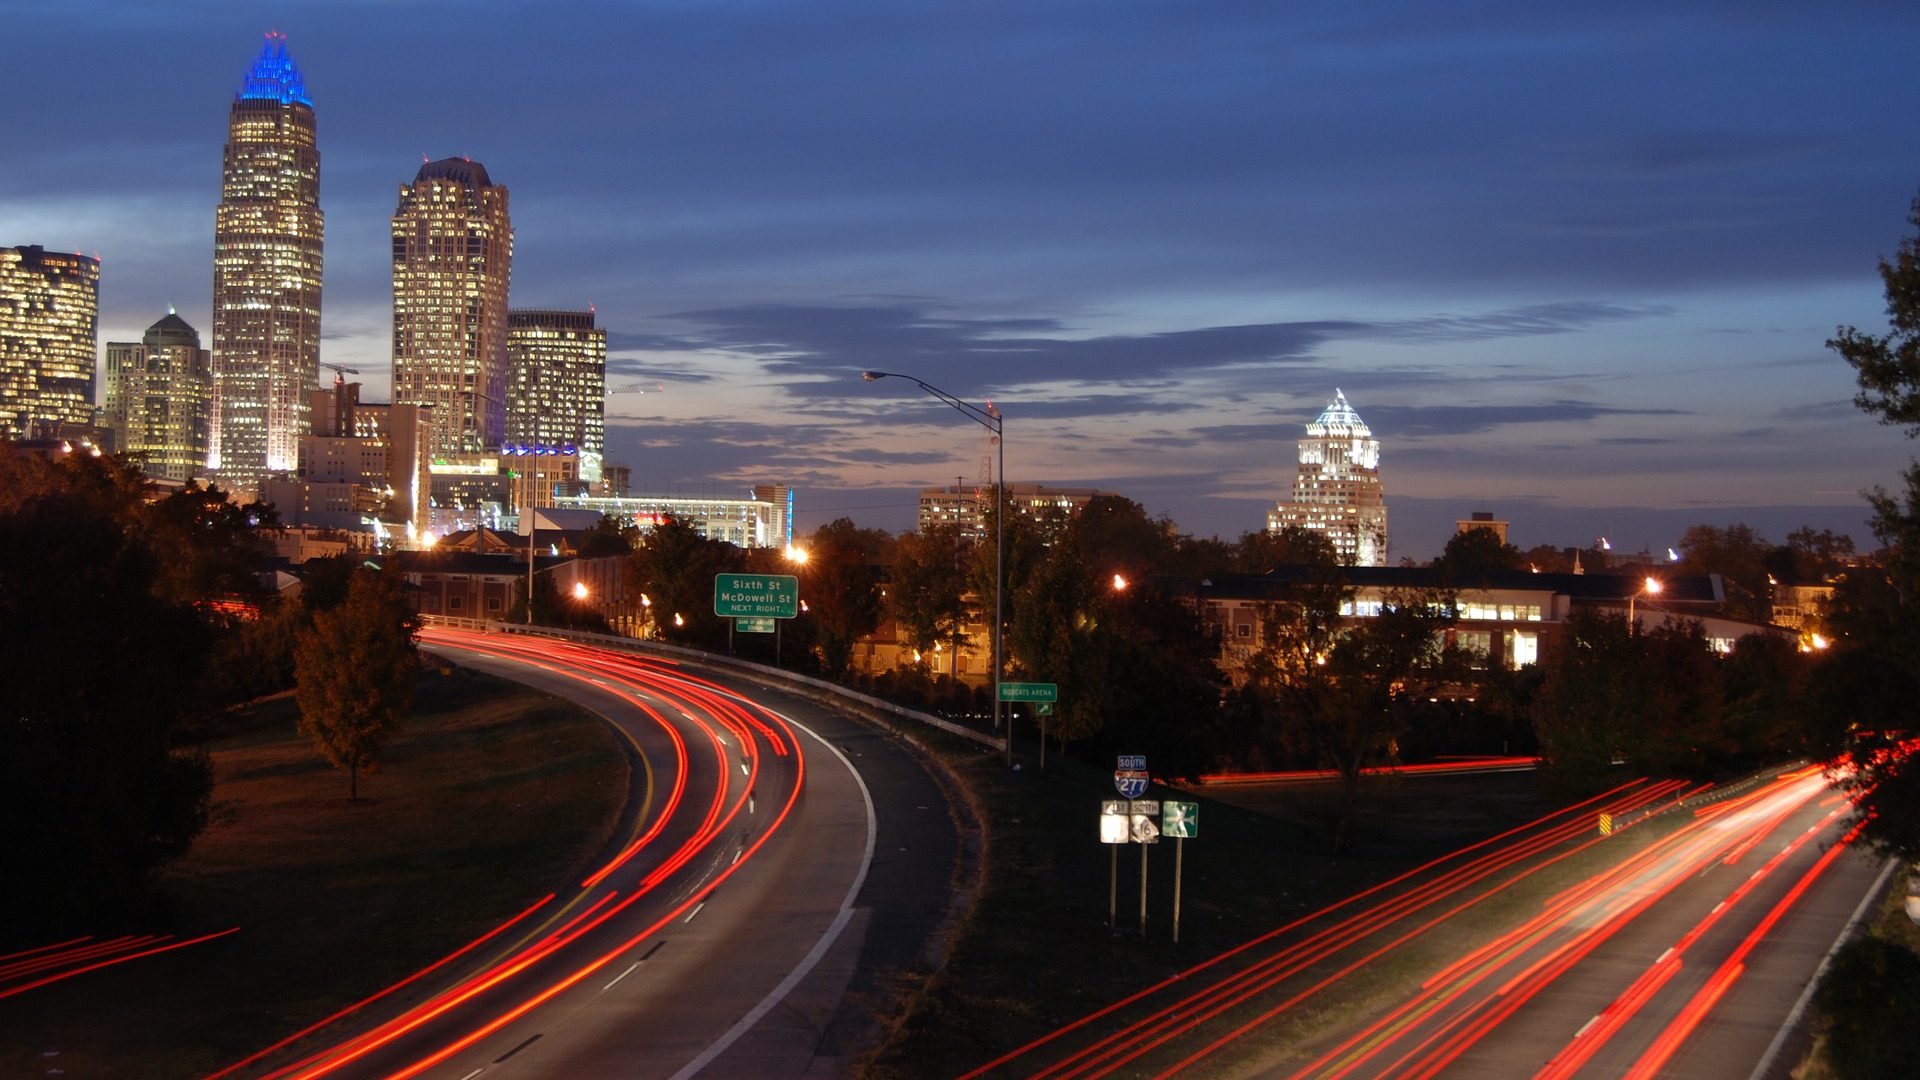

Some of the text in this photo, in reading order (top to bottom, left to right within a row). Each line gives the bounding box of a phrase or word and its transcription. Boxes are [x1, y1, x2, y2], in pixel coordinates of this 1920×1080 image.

[733, 580, 781, 590] Sixth St
[721, 592, 791, 603] McDowell St
[731, 604, 752, 612] NEXT
[1003, 688, 1029, 696] BOBCATS
[1120, 758, 1145, 768] SOUTH
[1120, 778, 1146, 792] 277
[1140, 823, 1151, 835] 16
